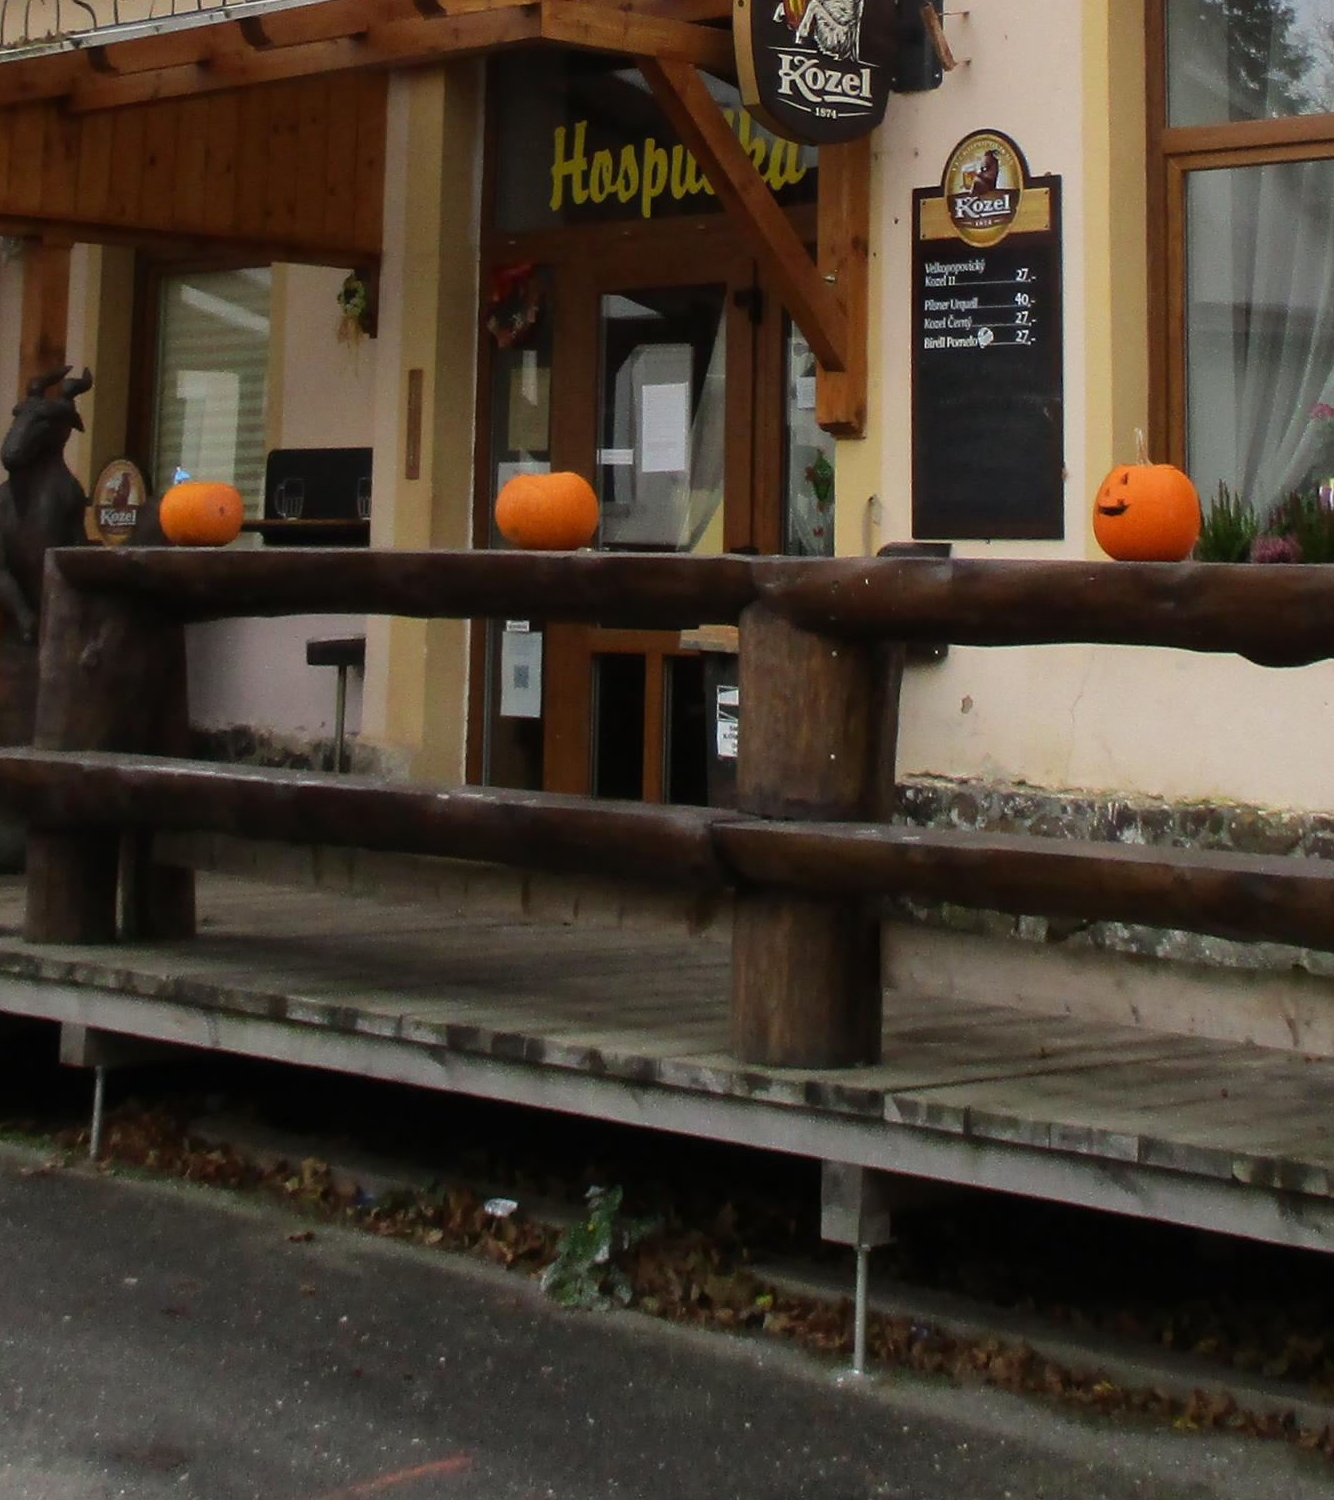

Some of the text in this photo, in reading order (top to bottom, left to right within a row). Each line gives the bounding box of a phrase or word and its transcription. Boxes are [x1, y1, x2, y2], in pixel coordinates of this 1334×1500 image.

[777, 53, 874, 107] Kozel
[815, 108, 838, 120] 1874
[954, 194, 1011, 219] Kozel
[925, 275, 947, 287] Kozel
[924, 299, 950, 311] Pilsner
[950, 297, 978, 312] Urquell
[924, 317, 947, 329] Kozel
[947, 315, 973, 330] Černý
[100, 509, 136, 526] Kozel
